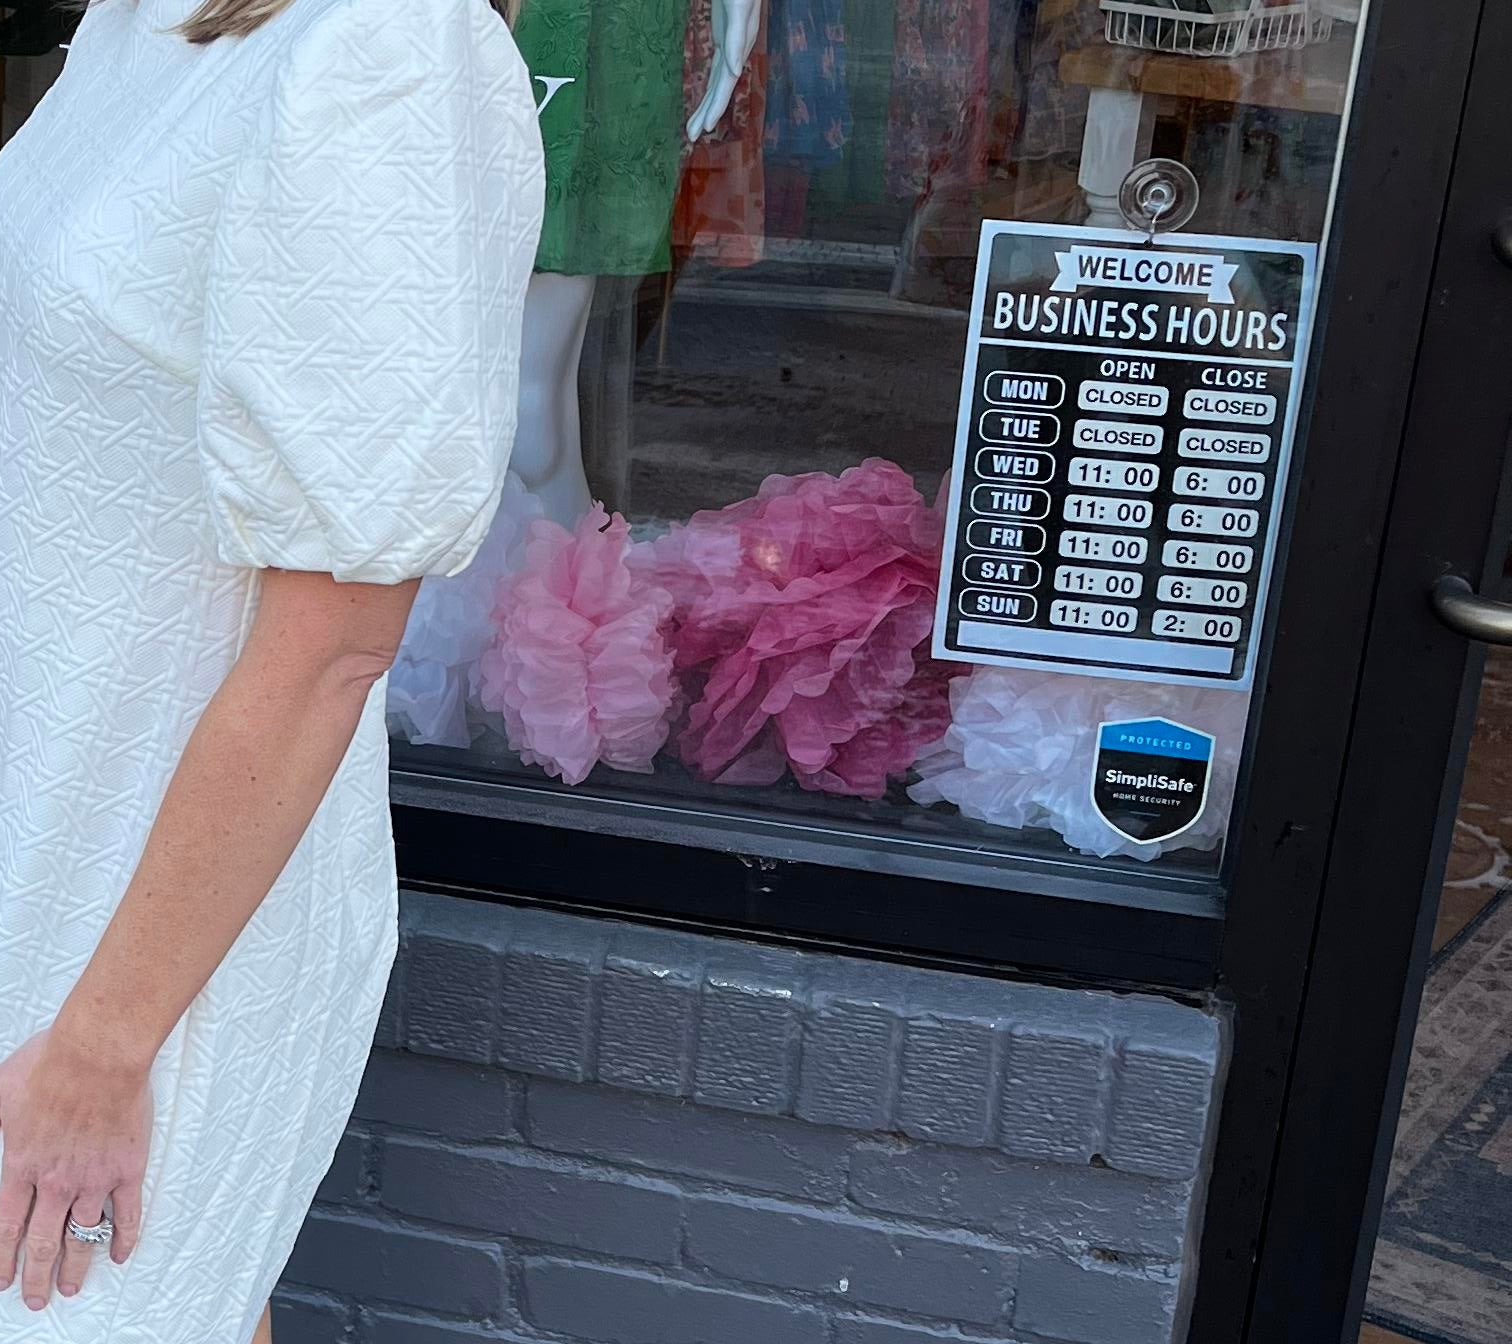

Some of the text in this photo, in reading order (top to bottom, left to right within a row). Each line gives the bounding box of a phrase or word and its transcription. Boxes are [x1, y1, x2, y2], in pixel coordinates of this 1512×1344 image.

[1078, 254, 1213, 287] WELCOME
[993, 292, 1288, 351] BUSINESS HOURS
[1100, 359, 1268, 389] OPEN CLOSE
[1000, 378, 1268, 417] MON CLOSED CLOSED
[1000, 417, 1264, 456] TUE CLOSED CLOSED
[992, 454, 1039, 476] WED
[990, 491, 1033, 512] THU
[989, 527, 1023, 547] FRI
[980, 561, 1024, 582] SAT
[977, 595, 1020, 616] SUN
[1120, 734, 1192, 751] PROTECTED
[1105, 769, 1194, 793] SimpliSafe
[1112, 792, 1182, 807] HOME SECURITY
